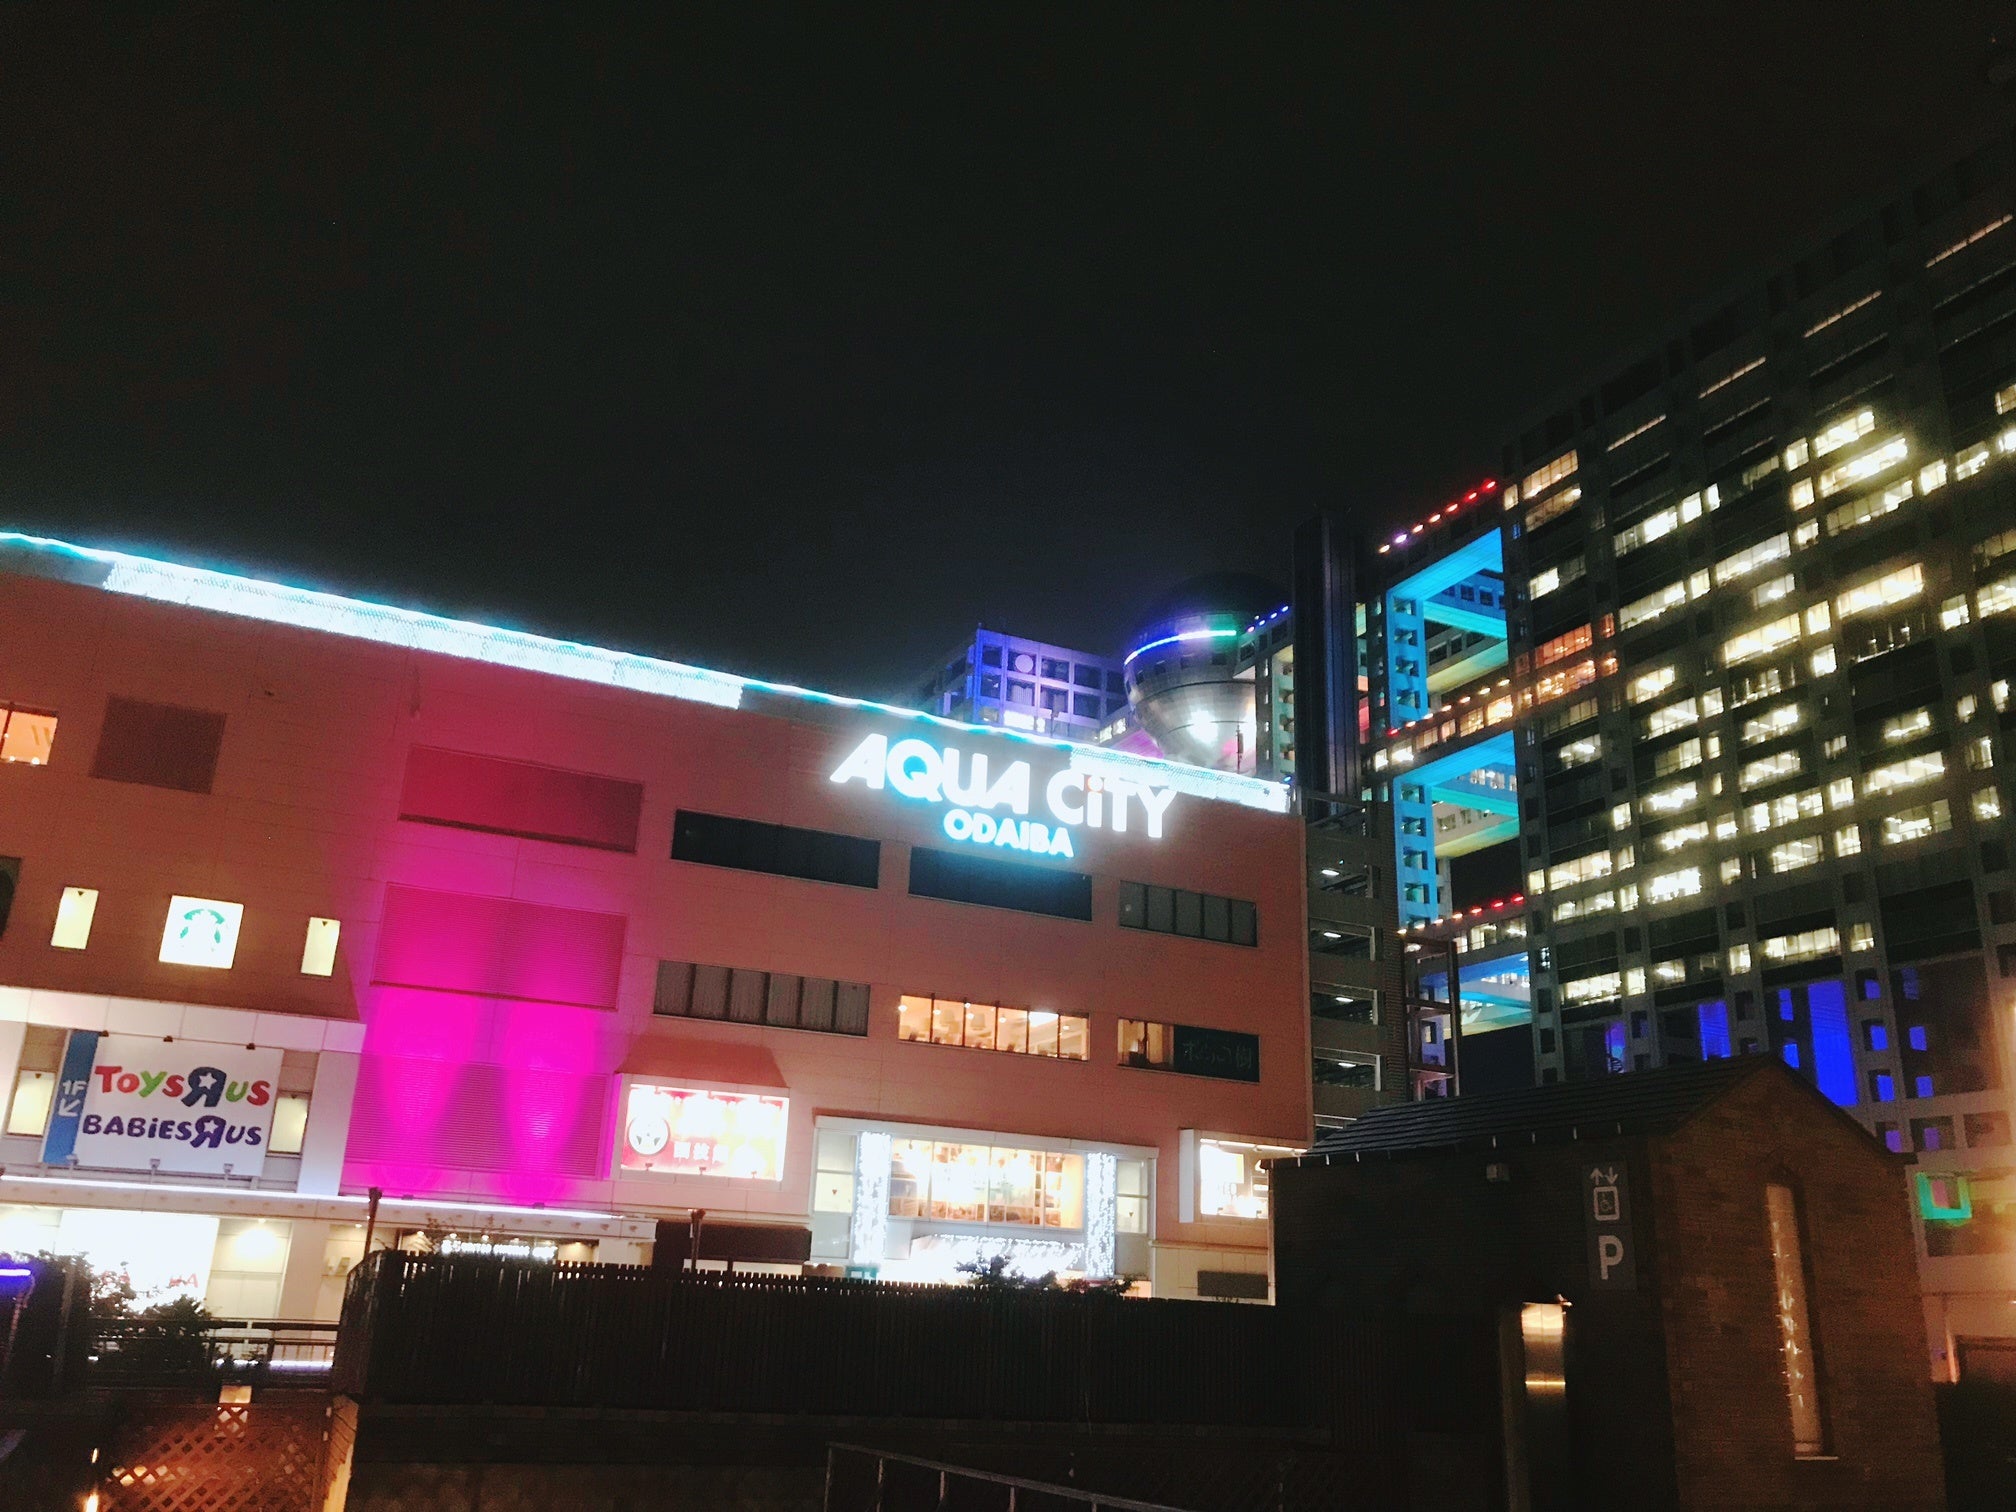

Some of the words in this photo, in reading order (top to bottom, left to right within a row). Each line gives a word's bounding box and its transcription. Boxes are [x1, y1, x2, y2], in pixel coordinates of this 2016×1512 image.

[829, 733, 1030, 815] AQUA
[943, 809, 1074, 858] ODAIBA
[63, 1079, 86, 1096] 1F
[1598, 1235, 1624, 1280] P
